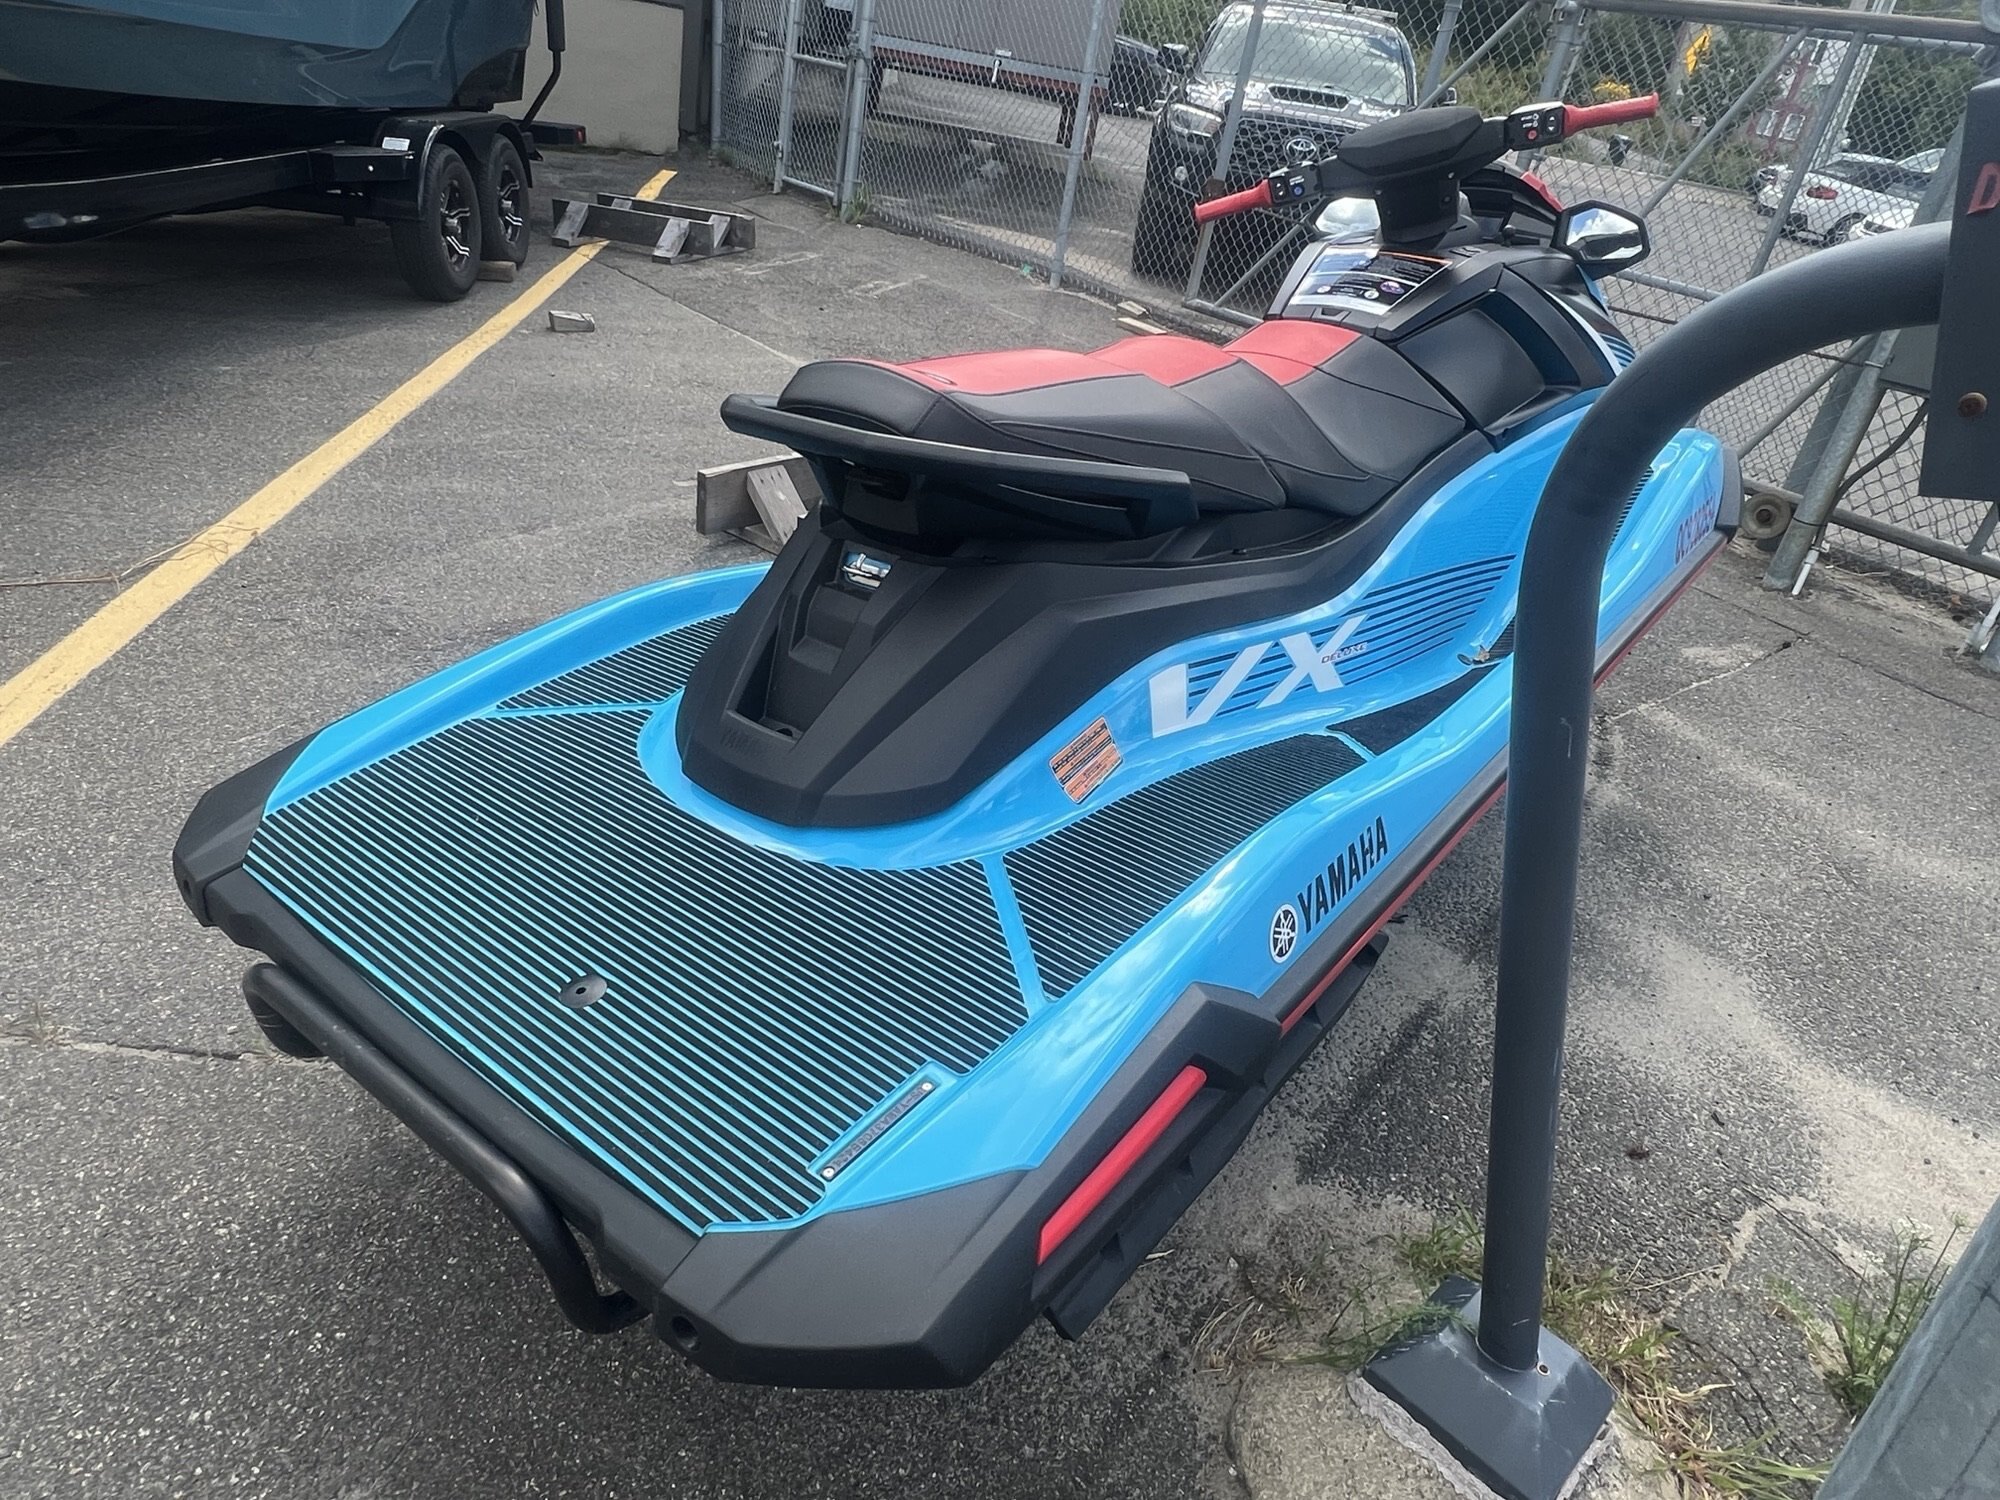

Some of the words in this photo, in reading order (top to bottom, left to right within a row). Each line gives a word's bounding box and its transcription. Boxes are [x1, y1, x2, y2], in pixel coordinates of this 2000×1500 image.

[1149, 614, 1368, 738] VX
[1321, 642, 1367, 664] DELUXE
[1297, 815, 1388, 934] YAMAHA
